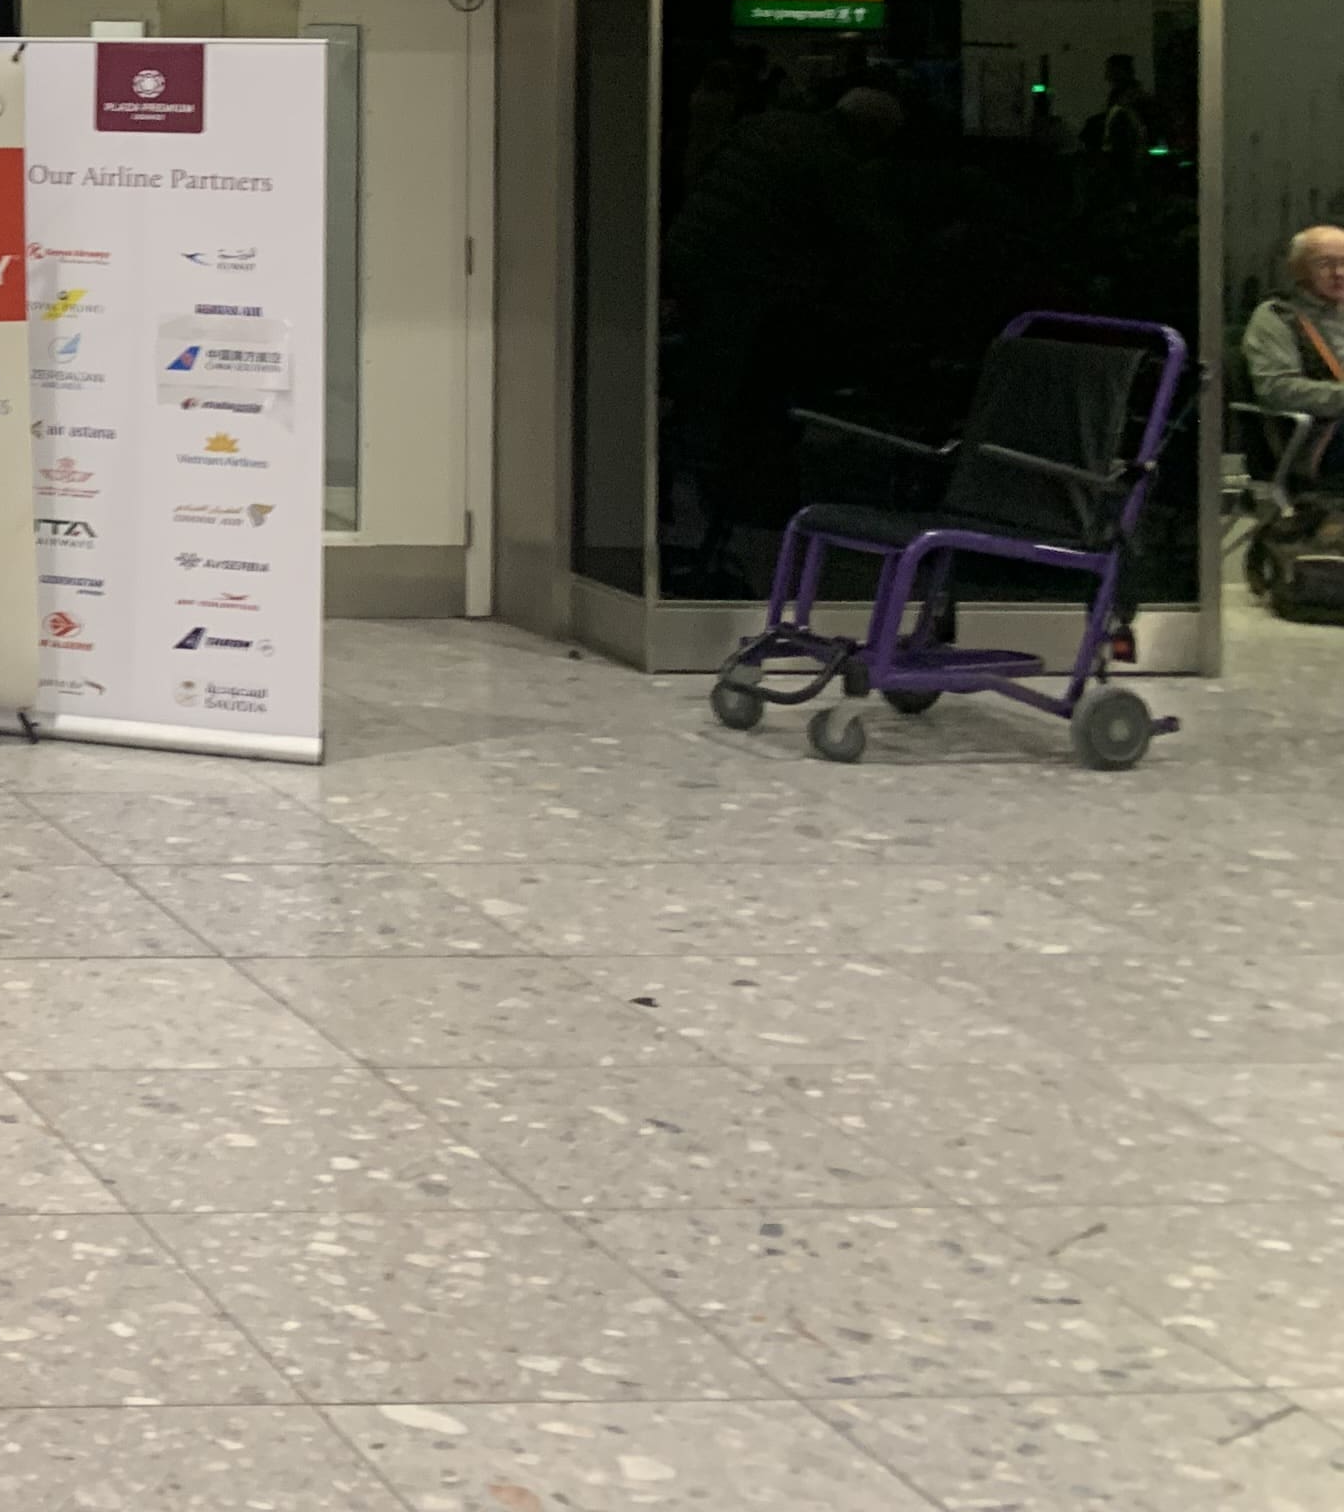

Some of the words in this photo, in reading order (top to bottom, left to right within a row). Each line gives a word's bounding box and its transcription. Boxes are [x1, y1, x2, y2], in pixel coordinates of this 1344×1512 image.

[28, 164, 74, 185] Our
[81, 166, 164, 189] Airline
[170, 169, 274, 192] Partners
